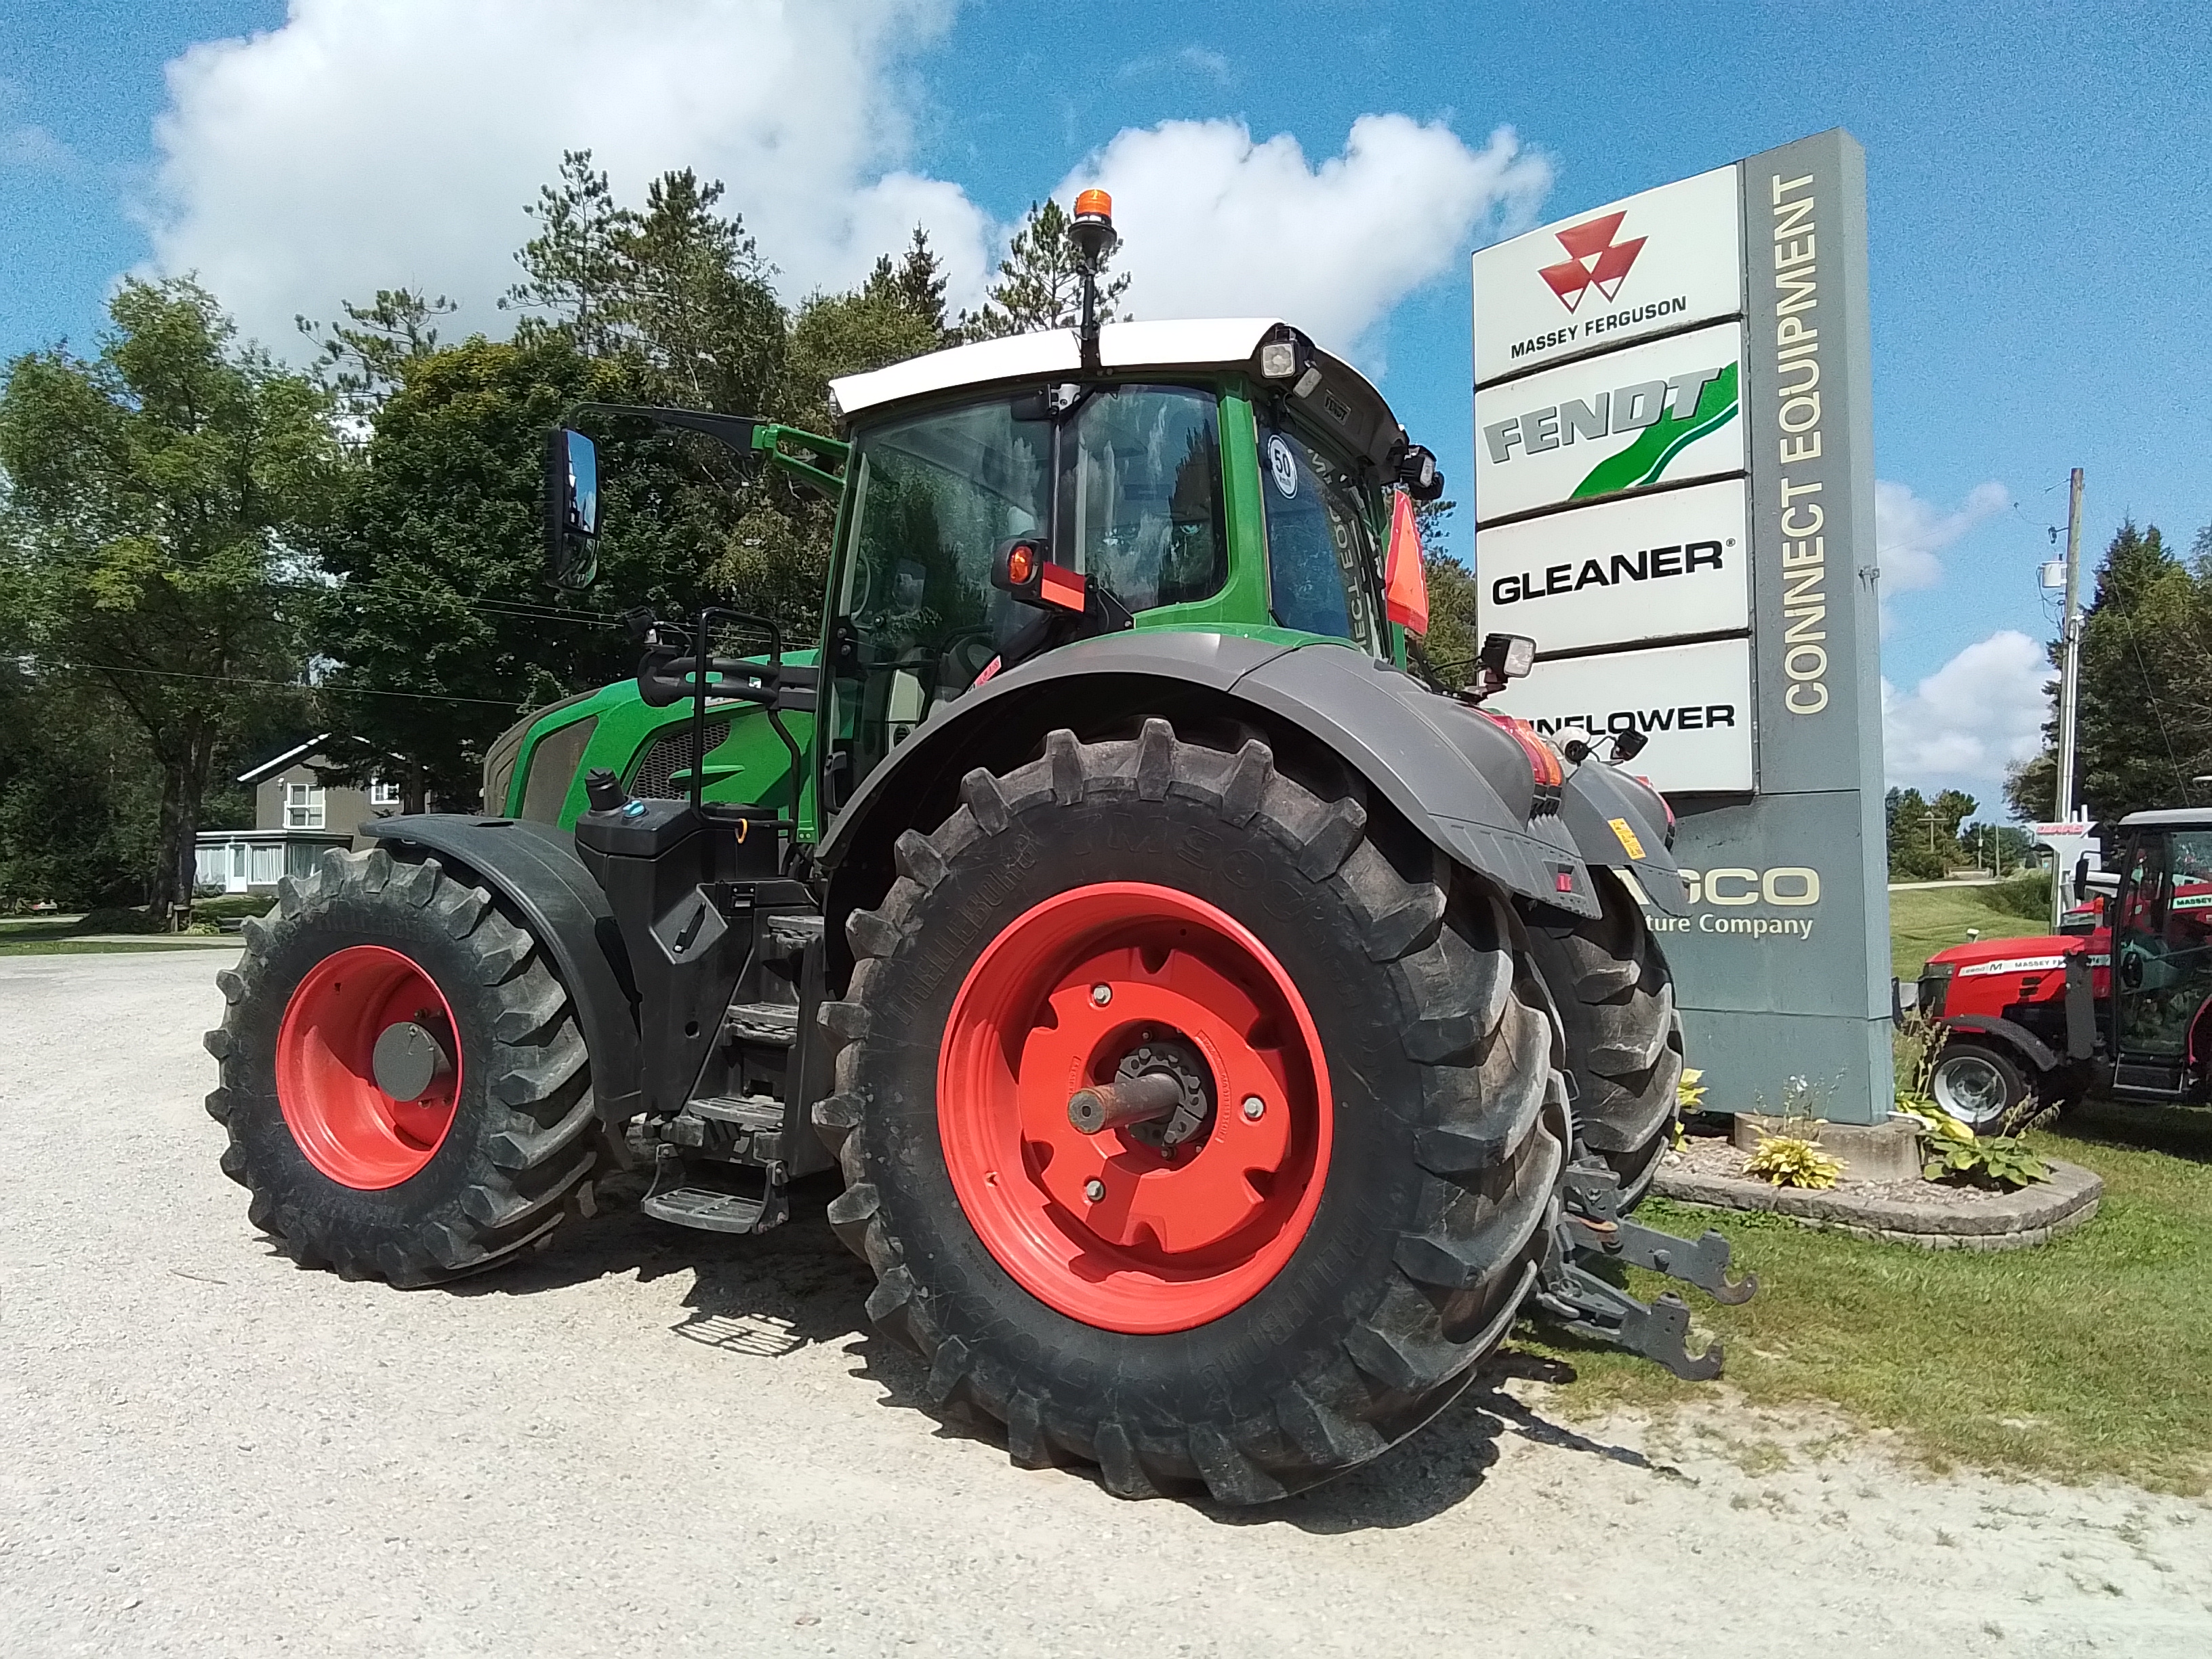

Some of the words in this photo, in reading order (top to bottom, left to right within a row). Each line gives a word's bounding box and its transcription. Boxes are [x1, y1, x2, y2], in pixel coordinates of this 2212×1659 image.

[1511, 324, 1578, 359] MASSEY
[1584, 296, 1687, 338] FERGUSON
[1772, 173, 1822, 465] EQUIPMENT
[1483, 367, 1722, 465] FENDT
[1274, 448, 1291, 478] 50
[1781, 477, 1828, 716] CONNECT
[1699, 914, 1814, 940] Company
